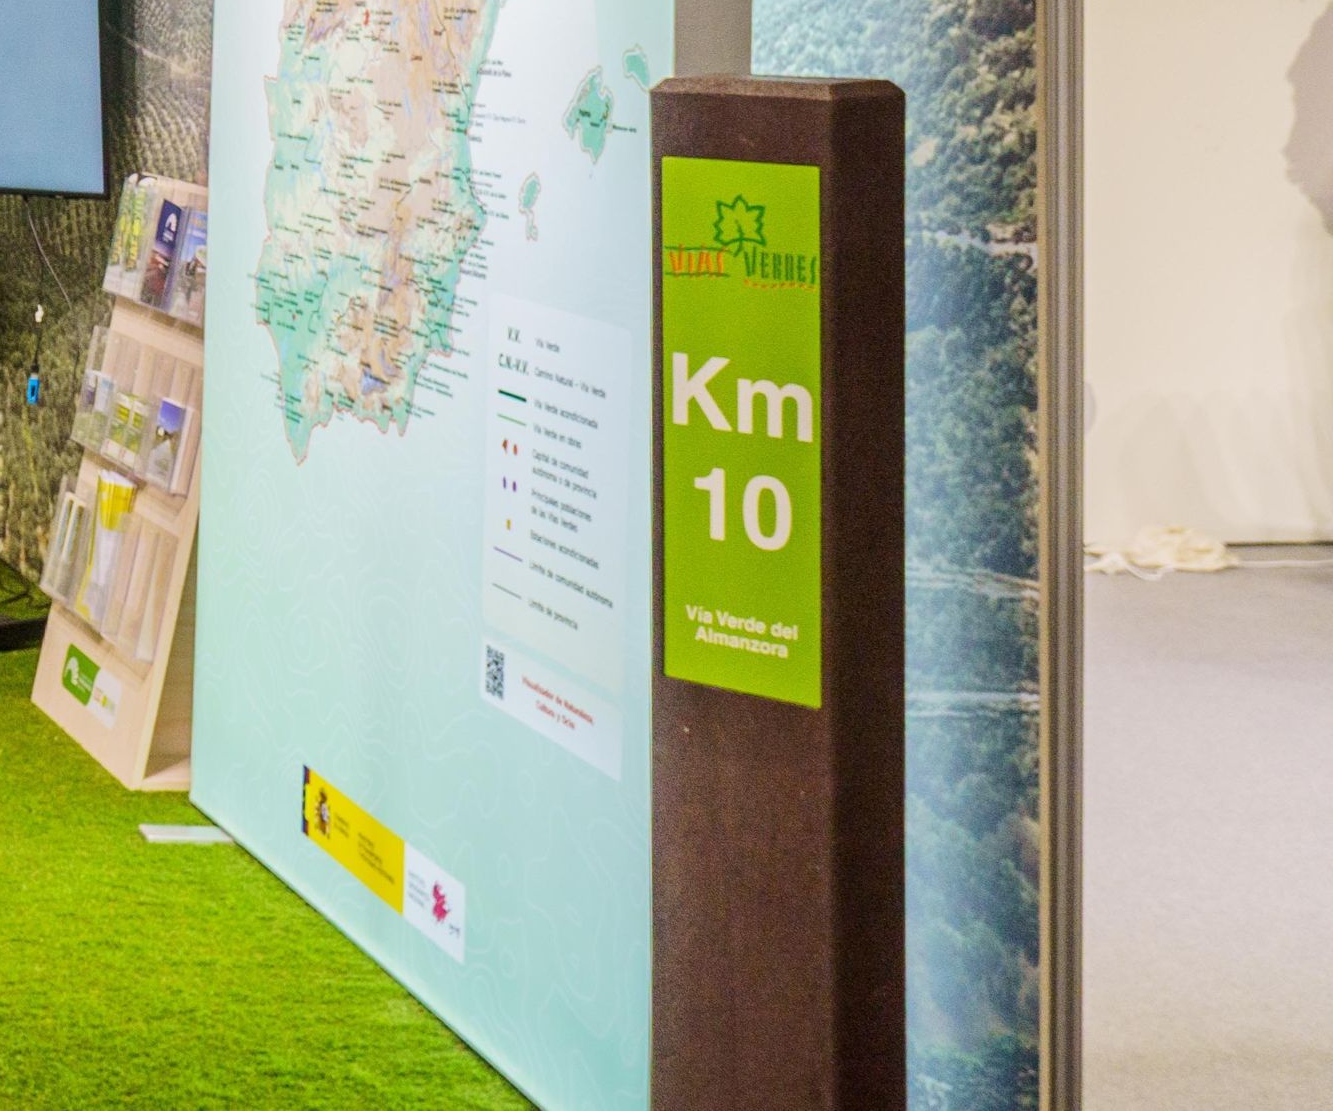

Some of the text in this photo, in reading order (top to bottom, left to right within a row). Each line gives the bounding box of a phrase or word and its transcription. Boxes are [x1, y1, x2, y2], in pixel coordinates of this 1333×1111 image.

[666, 243, 817, 285] VIAS VERDES
[672, 351, 813, 443] Km
[694, 467, 793, 552] 10
[685, 603, 799, 641] Vía Verde del
[695, 626, 789, 660] Almanzora
